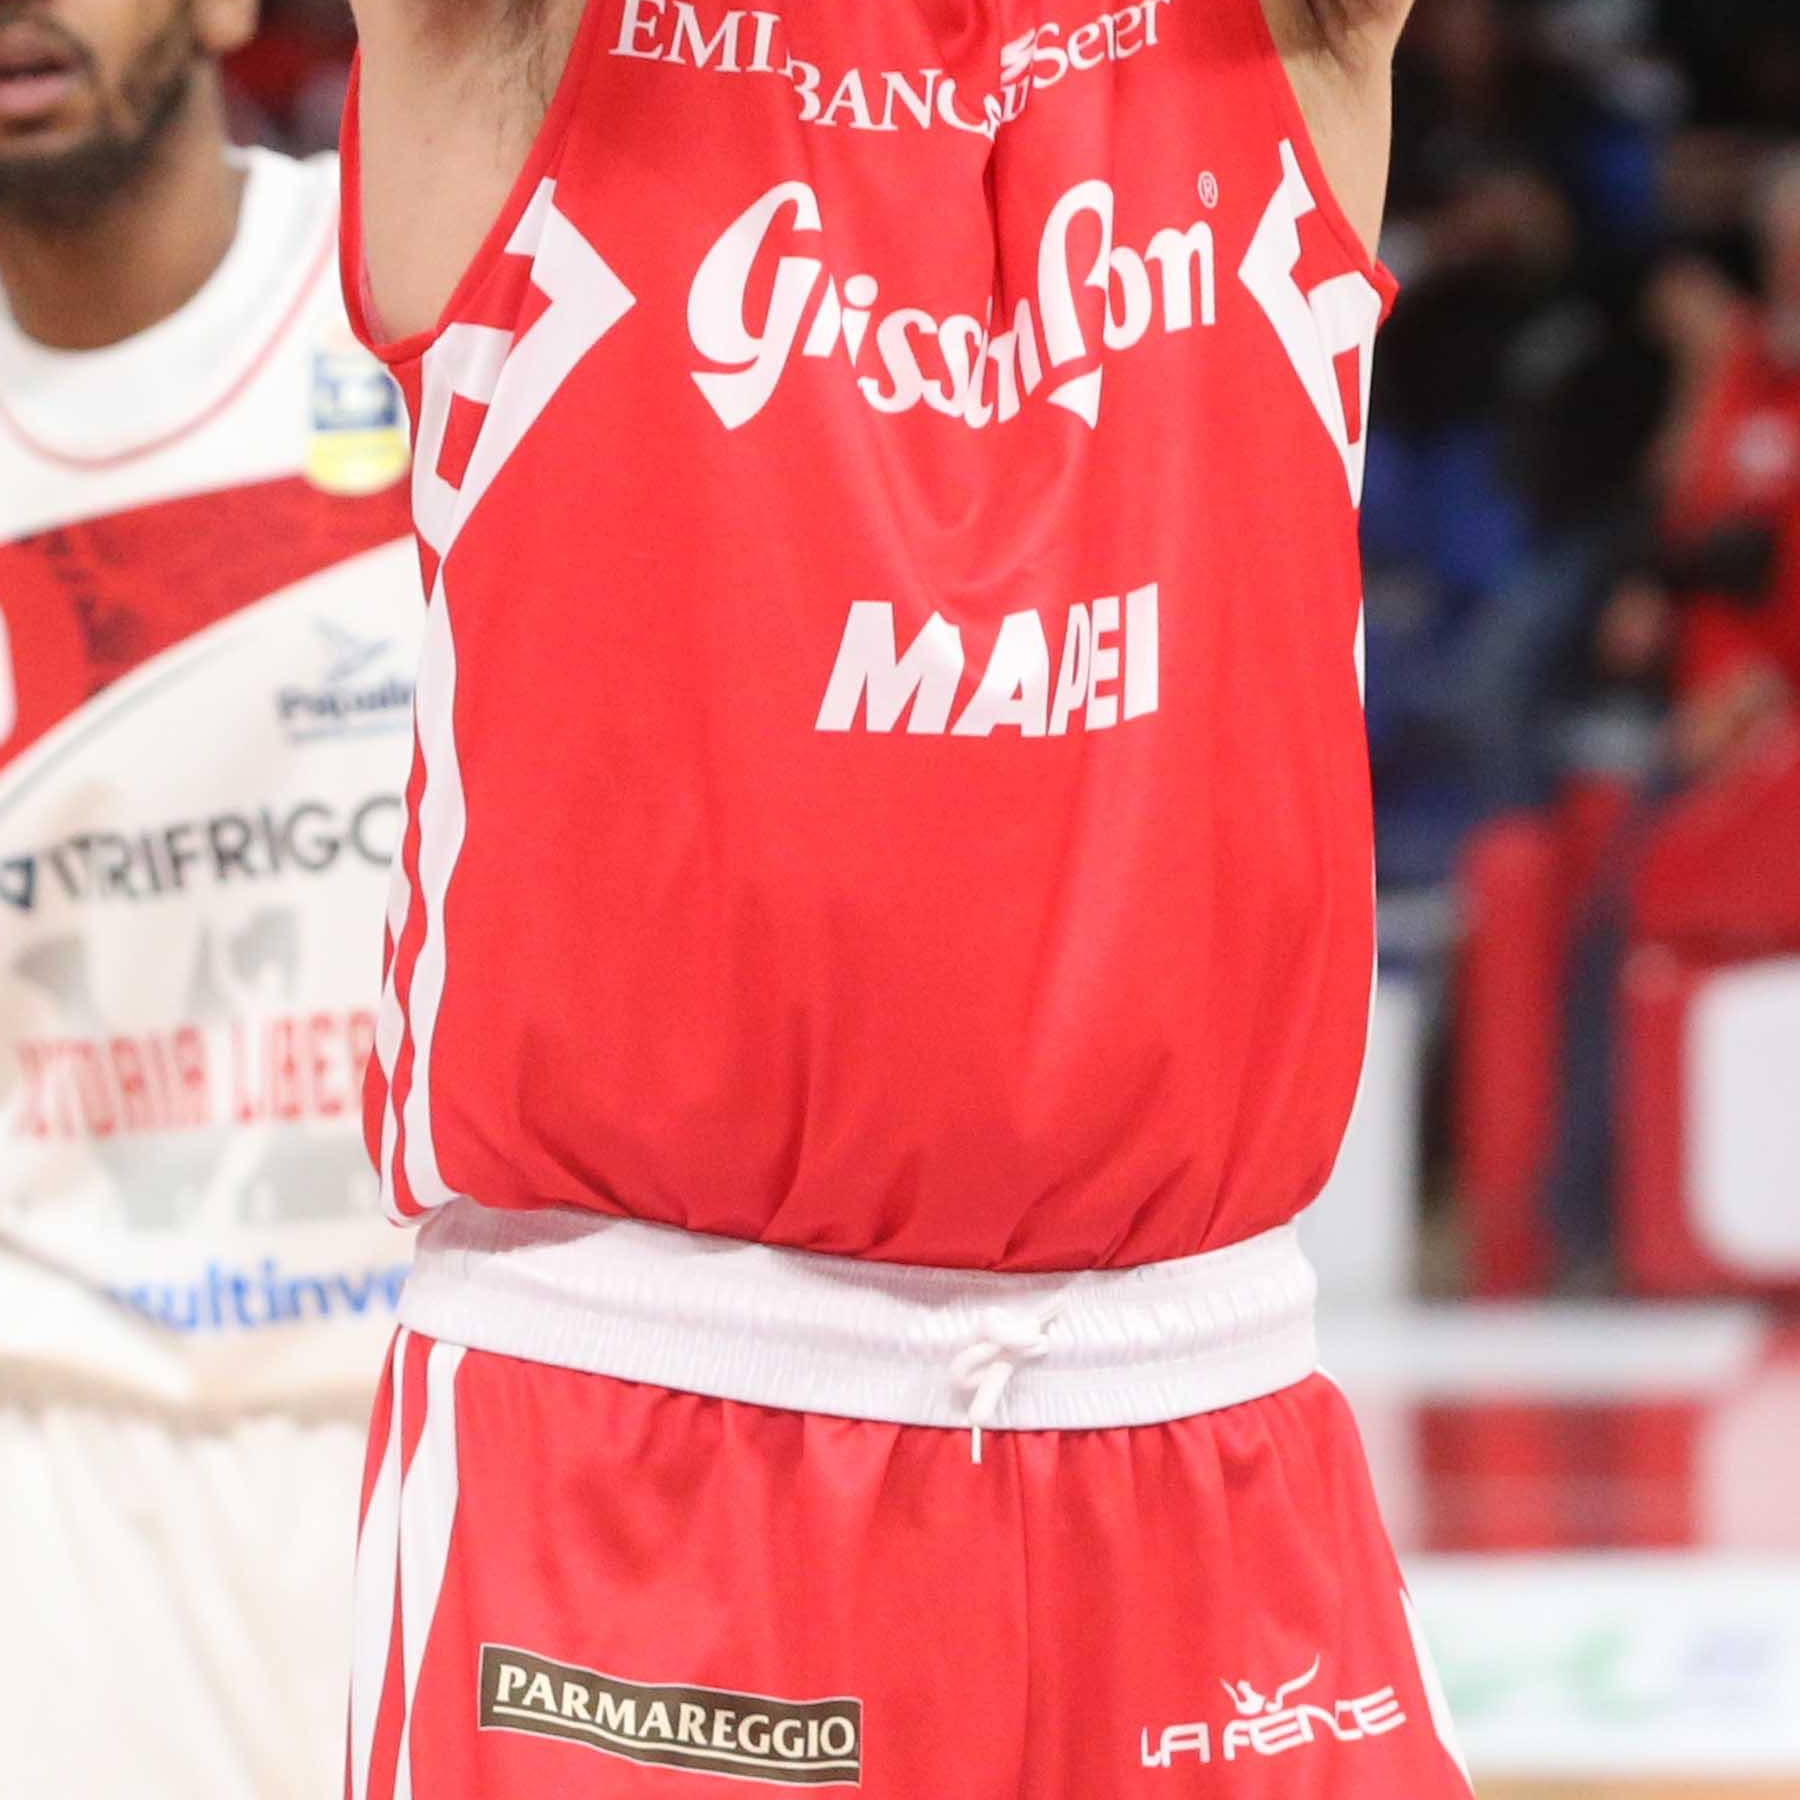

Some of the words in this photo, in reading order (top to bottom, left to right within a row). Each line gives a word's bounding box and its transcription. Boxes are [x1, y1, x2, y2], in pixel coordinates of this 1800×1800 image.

[814, 583, 1159, 737] MAPEI
[495, 1663, 856, 1759] PARMAREGGIO
[1140, 1722, 1211, 1769] LA
[1222, 1684, 1407, 1762] FENCE
